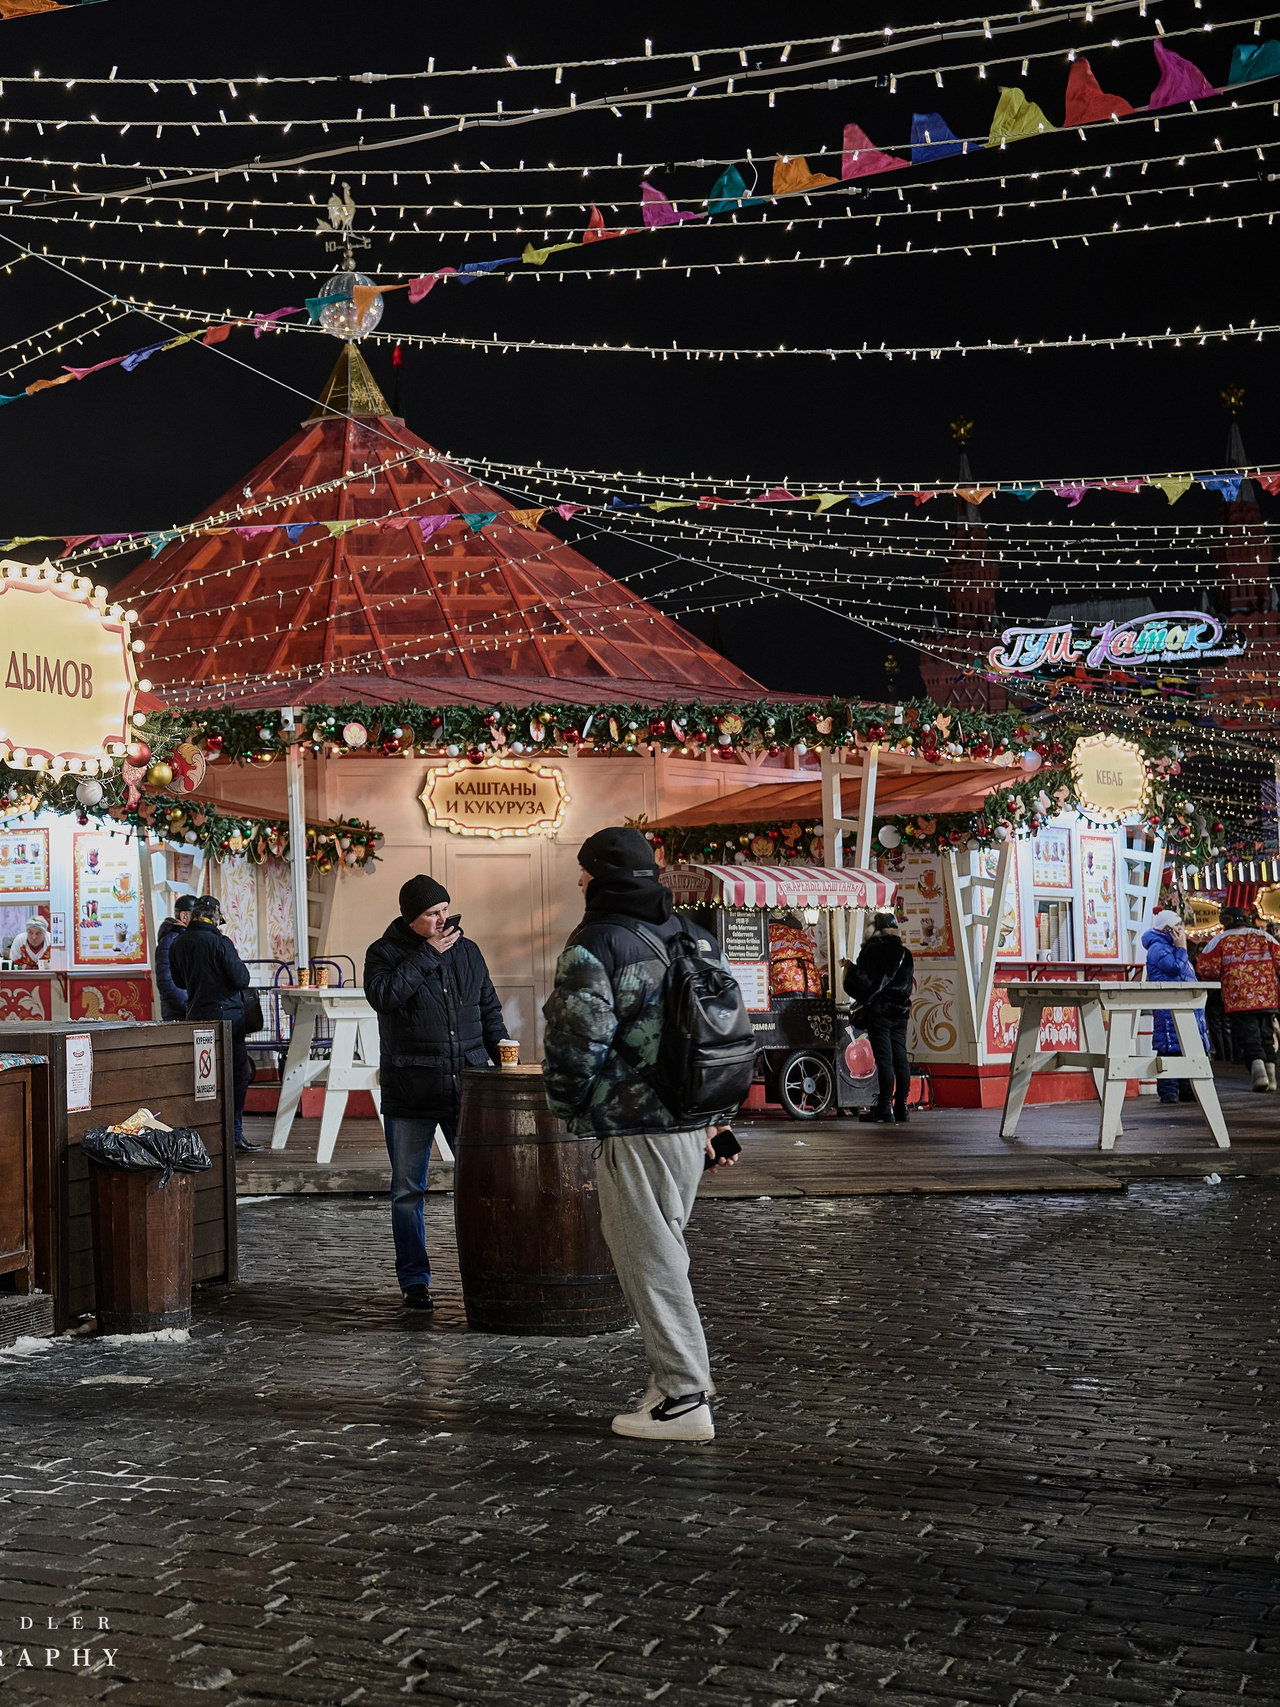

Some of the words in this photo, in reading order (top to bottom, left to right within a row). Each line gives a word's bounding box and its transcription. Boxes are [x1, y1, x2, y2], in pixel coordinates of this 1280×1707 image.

[5, 650, 93, 700] ДЫМОВ
[1096, 769, 1123, 787] КЕБАБ
[455, 782, 536, 796] КАШТАНЫ
[446, 801, 458, 814] И
[465, 801, 546, 815] КУКУРУЗА
[784, 881, 821, 892] ЖАРЕНЫЕ
[822, 881, 859, 892] КАШТАНЫ
[752, 1023, 776, 1033] рамели
[196, 1036, 213, 1045] КУРЕНИЕ
